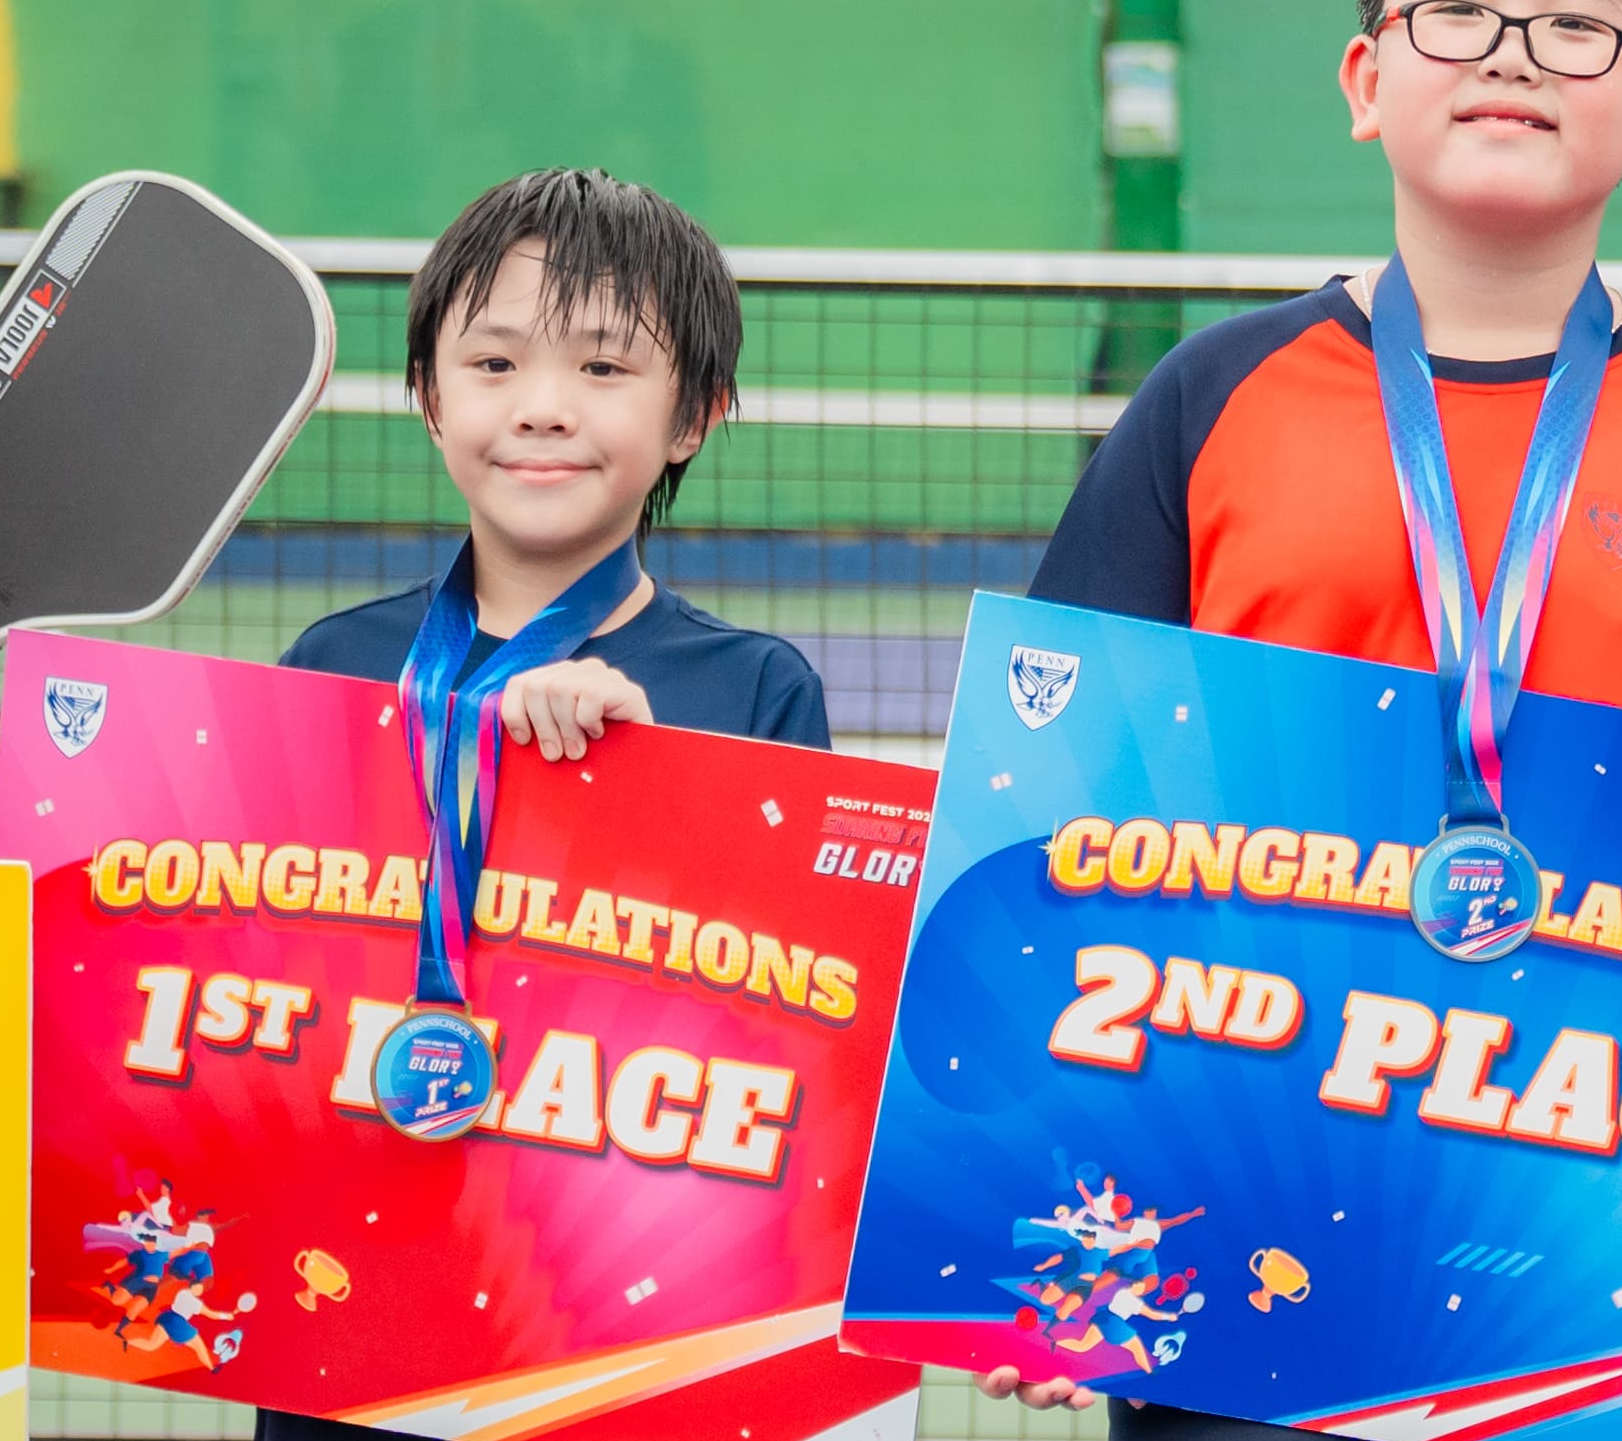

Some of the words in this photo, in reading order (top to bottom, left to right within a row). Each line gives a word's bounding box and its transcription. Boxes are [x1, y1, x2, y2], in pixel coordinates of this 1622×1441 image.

[826, 796, 870, 812] SPORT
[872, 802, 905, 817] FEST
[907, 809, 931, 823] 202
[1442, 835, 1512, 856] PENNSCHOOL
[813, 842, 921, 887] GLOR
[90, 838, 860, 1027] CONGRAULATIONS
[1047, 944, 1304, 1075] 2ND
[124, 965, 314, 1082] 1ST
[330, 996, 801, 1187] ACE
